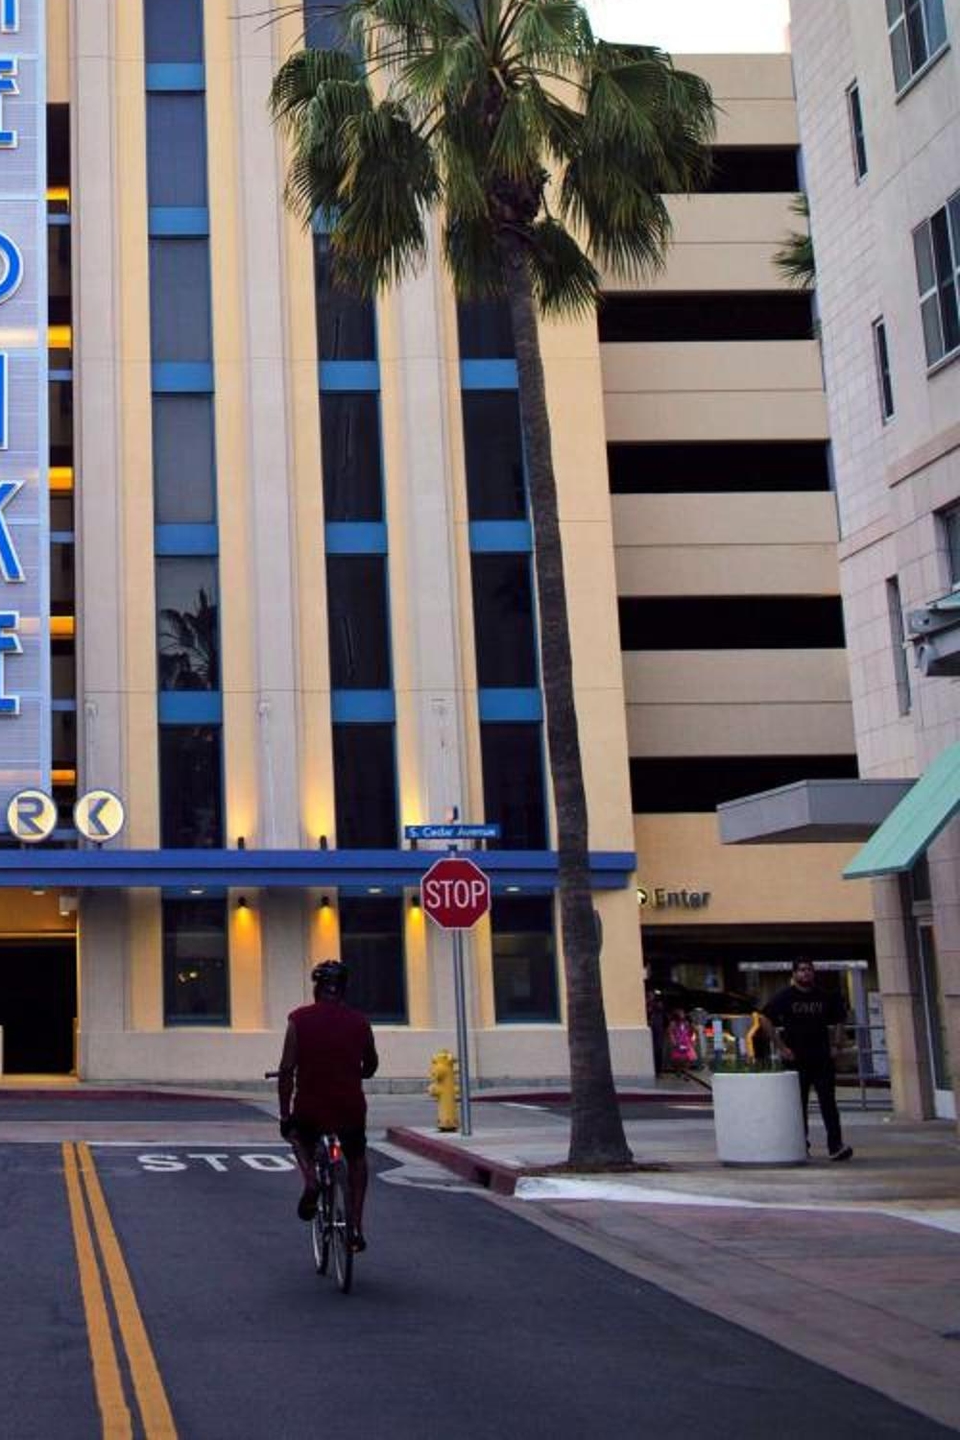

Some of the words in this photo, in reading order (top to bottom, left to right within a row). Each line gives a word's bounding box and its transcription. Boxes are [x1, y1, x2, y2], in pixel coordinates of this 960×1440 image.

[422, 827, 453, 838] Cedar
[456, 827, 497, 838] Avenue
[425, 880, 486, 909] STOP
[653, 888, 711, 910] Enter
[137, 1153, 297, 1173] STO
